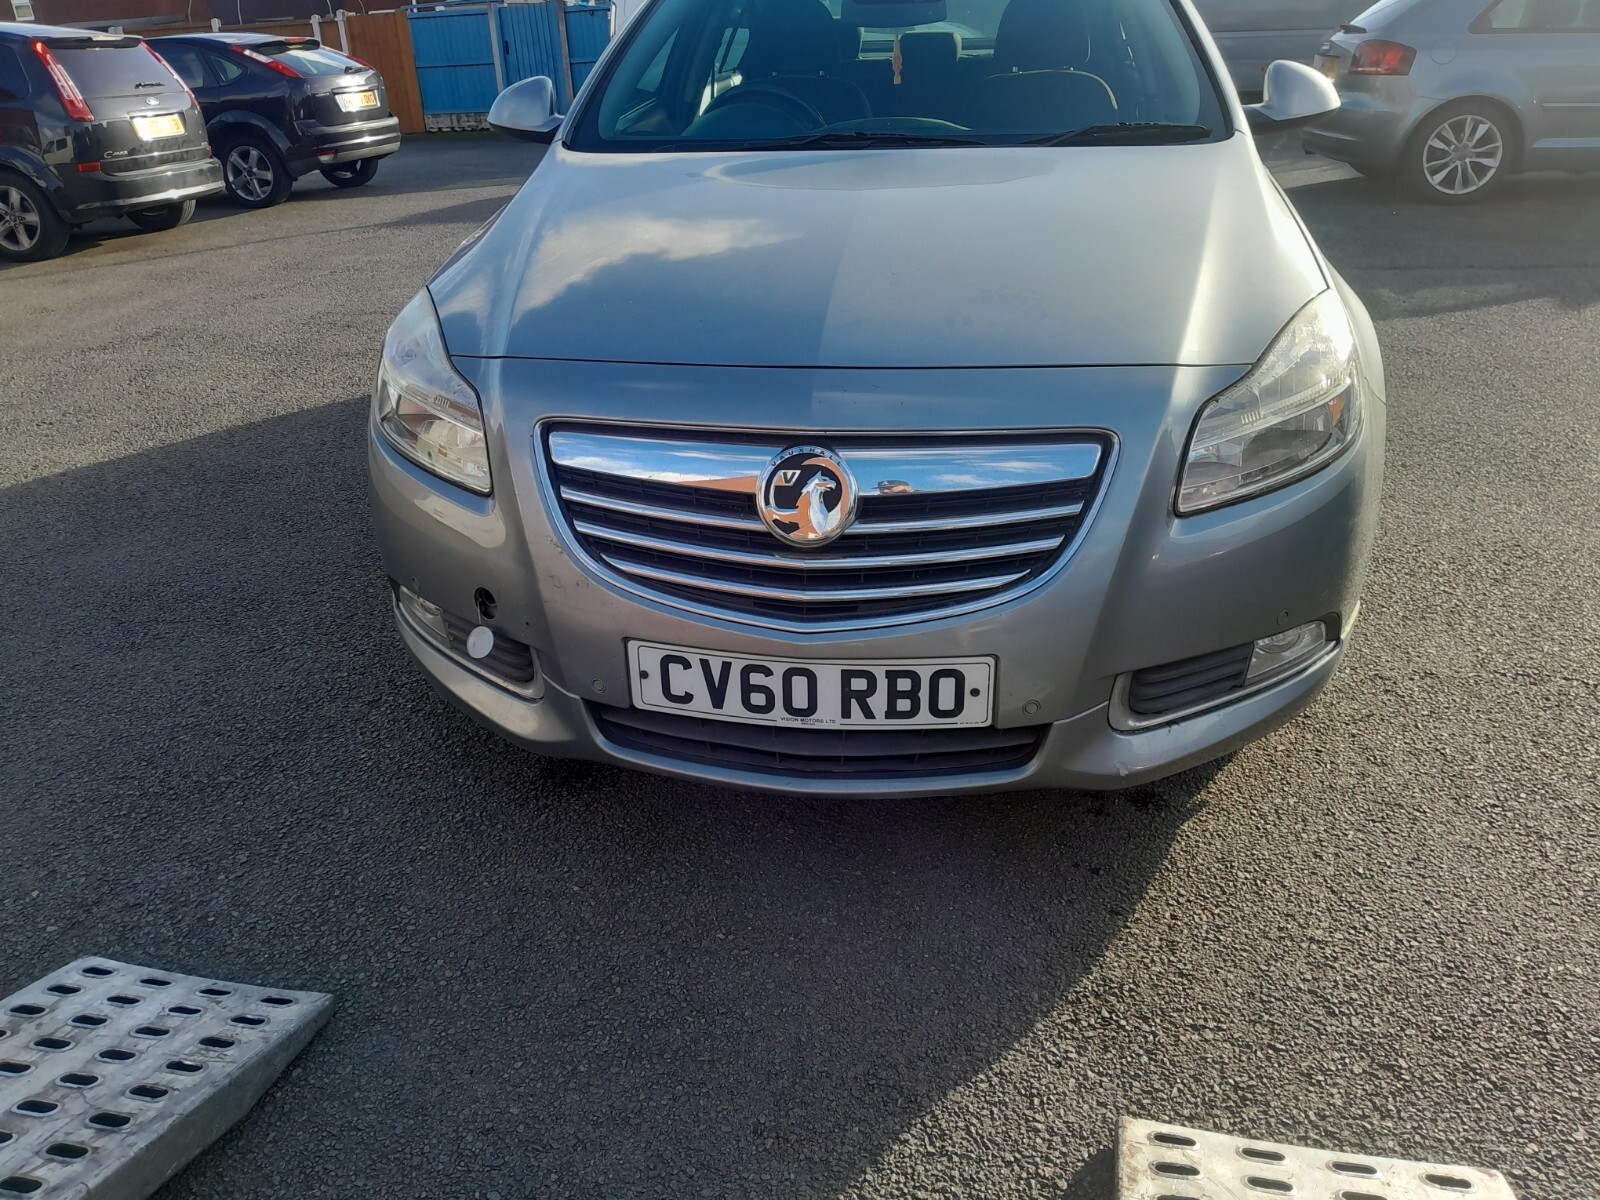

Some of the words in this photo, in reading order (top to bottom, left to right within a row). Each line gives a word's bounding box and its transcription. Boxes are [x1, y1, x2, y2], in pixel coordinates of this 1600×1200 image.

[771, 448, 843, 467] VAUXHALL
[659, 654, 818, 718] CV60
[840, 668, 966, 720] RBO
